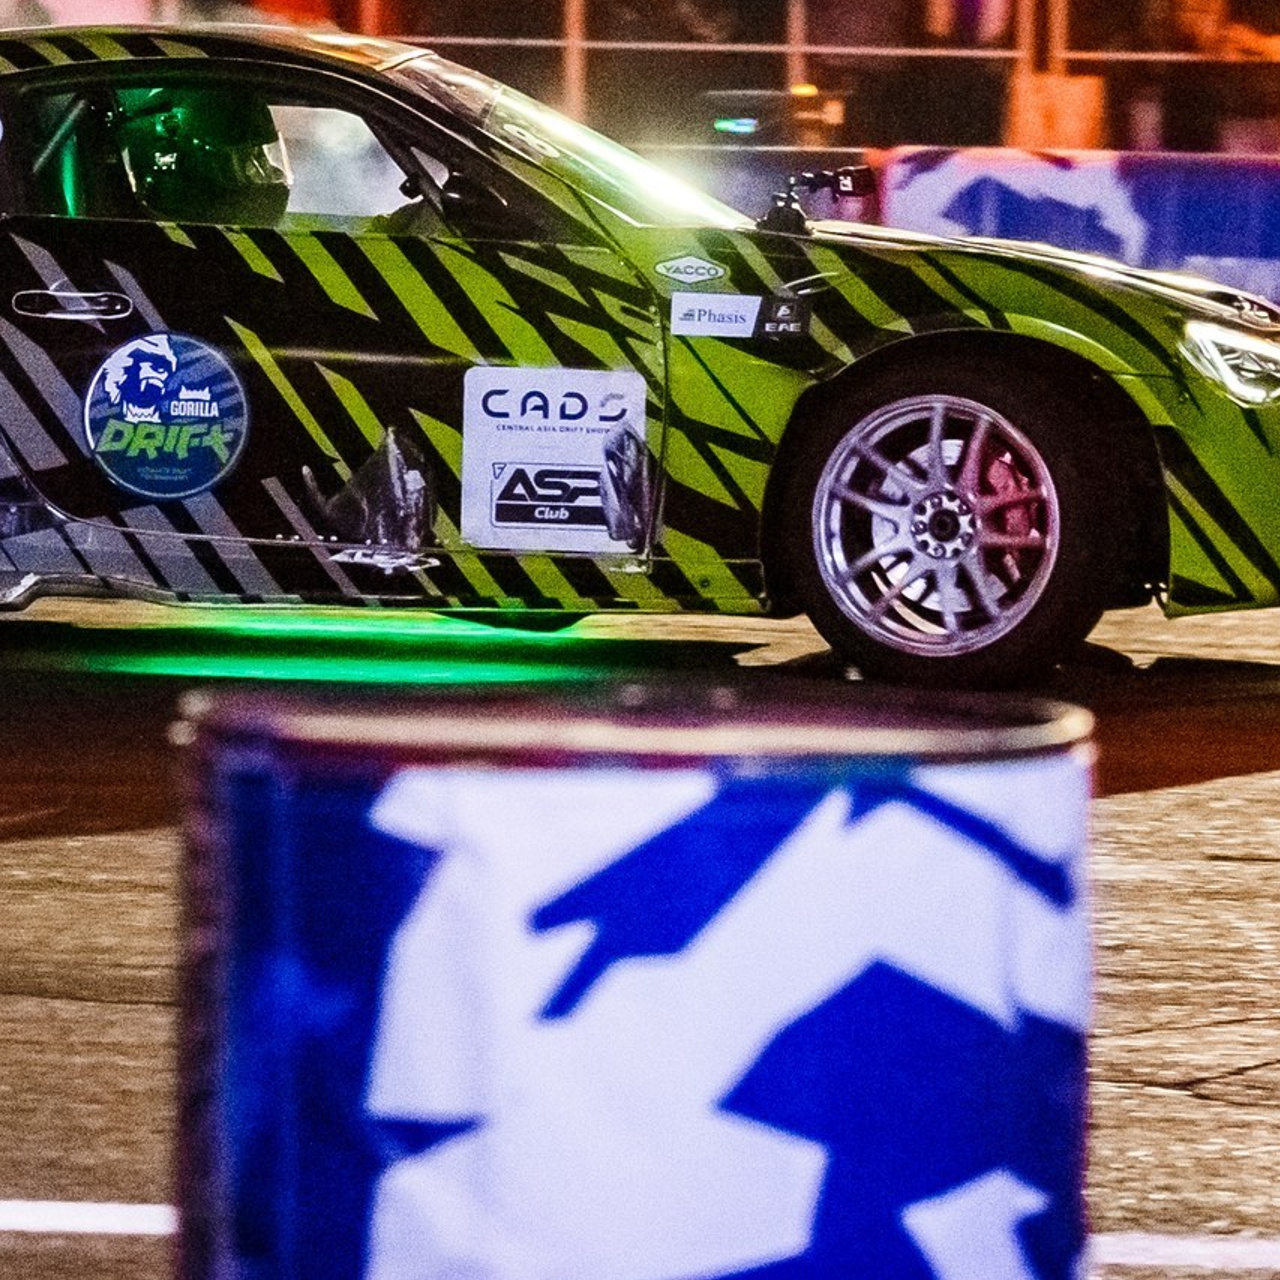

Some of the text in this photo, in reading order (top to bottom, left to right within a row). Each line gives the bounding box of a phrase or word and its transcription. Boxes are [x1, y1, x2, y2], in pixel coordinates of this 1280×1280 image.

[663, 264, 719, 277] YACCO
[696, 308, 747, 325] Phasis
[170, 401, 219, 418] GORILLA
[481, 388, 628, 422] CADS
[496, 423, 535, 432] CENTRAL
[537, 424, 557, 433] ASIA
[559, 425, 583, 434] DRIFT
[94, 419, 234, 464] DRIFT
[534, 506, 570, 519] Club
